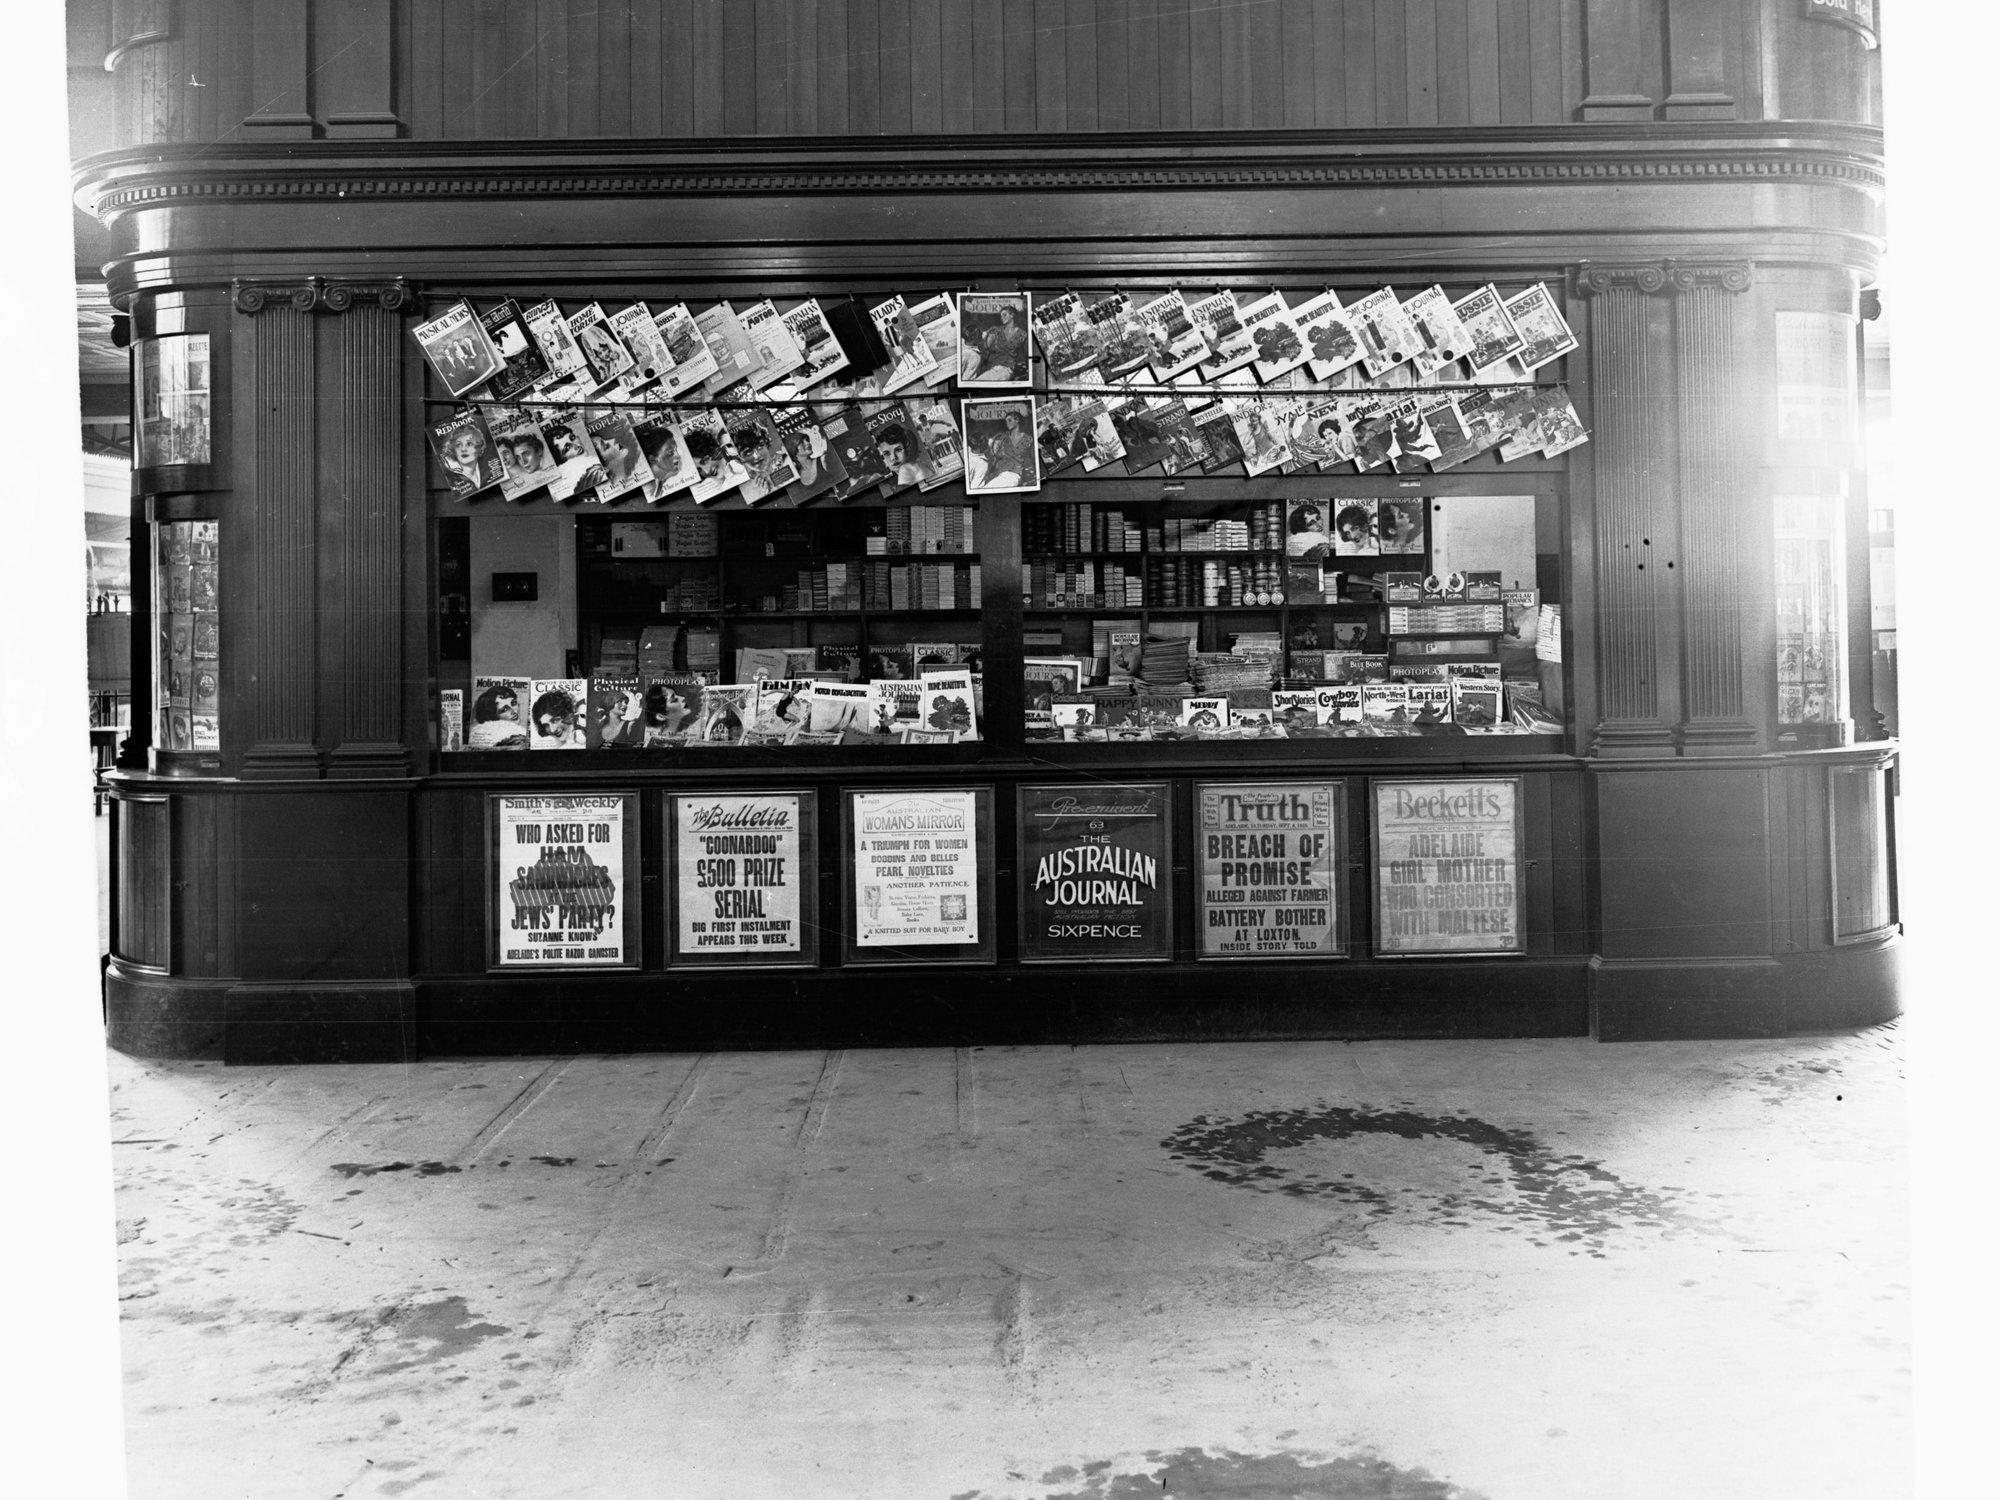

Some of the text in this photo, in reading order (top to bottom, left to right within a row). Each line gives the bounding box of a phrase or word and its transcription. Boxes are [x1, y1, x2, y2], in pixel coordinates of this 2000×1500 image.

[1362, 290, 1393, 312] JOURNAL
[1412, 288, 1442, 311] JOURNAL
[451, 308, 469, 328] NEWS
[570, 308, 594, 328] HOME
[615, 306, 647, 327] JOURNAL
[747, 308, 775, 330] MOTOR
[1308, 401, 1339, 420] NEW
[1385, 400, 1417, 422] ariat
[1435, 398, 1452, 410] Story
[552, 411, 578, 430] Picture
[876, 408, 906, 425] Story
[1156, 408, 1186, 428] STRAND
[1338, 499, 1374, 507] CLASSIC
[918, 649, 953, 657] CLASSIC
[1392, 668, 1442, 676] PHOTOPLAY
[1448, 665, 1499, 675] Motion Picture
[476, 678, 528, 688] Motion Picture
[535, 684, 582, 692] CLASSIC
[594, 677, 639, 686] Physical
[652, 678, 703, 686] PHOTOPLAY
[879, 683, 922, 692] AUSTRALIAN
[928, 680, 967, 691] HOME BEAUTIFUL
[1483, 684, 1501, 692] Story
[814, 687, 831, 695] MOTOR
[1318, 690, 1358, 702] Cowboy
[1408, 689, 1448, 700] Lariat
[1097, 699, 1137, 708] HAPPY
[1141, 698, 1182, 708] SUNNY
[1189, 701, 1219, 709] MERRY
[505, 797, 621, 809] Smith's Weekly
[1221, 794, 1310, 822] Truth
[1393, 787, 1501, 819] Beckett's
[696, 804, 790, 832] Bulletin
[865, 815, 962, 830] WOMAN'S MIRROR
[1089, 821, 1104, 829] 63
[516, 824, 610, 844] WHO ASKED FOR
[1080, 835, 1111, 843] THE
[700, 835, 783, 855] "COONARDOO"
[861, 839, 968, 851] A TRIUMPH FOR WOMEN
[1208, 834, 1324, 859] BREACH OF
[1409, 833, 1485, 858] ADELAIDE
[540, 846, 585, 863] HAM
[871, 854, 959, 863] BOBBINS AND BELLES
[697, 858, 786, 887] £500 PRIZE
[876, 866, 954, 877] PEARL NOVELTIES
[1035, 846, 1156, 891] AUSTRALIAN
[1222, 862, 1311, 886] PROMISE
[1390, 859, 1506, 884] GIRL MOTHER
[1045, 880, 1144, 905] JOURNAL
[1206, 889, 1328, 903] ALLEGED AGAINST FARMER
[1423, 883, 1512, 908] CONSORTED
[715, 889, 766, 919] SERIAL
[511, 904, 615, 930] JEWS' PARTY?
[1209, 909, 1326, 927] BATTERY BOTHER
[1389, 909, 1510, 935] WITH MALTESE
[692, 920, 791, 933] BIG FIRST INSTALMENT
[1048, 924, 1142, 938] SIXPENCE
[528, 932, 598, 942] SUZANNE KNOWS
[697, 934, 787, 946] APPEARS THIS WEEK
[1235, 929, 1248, 941] AT
[507, 948, 619, 959] ADELAIDE'S POLITE RAZOR GANGSTER
[1220, 943, 1251, 951] INSIDE
